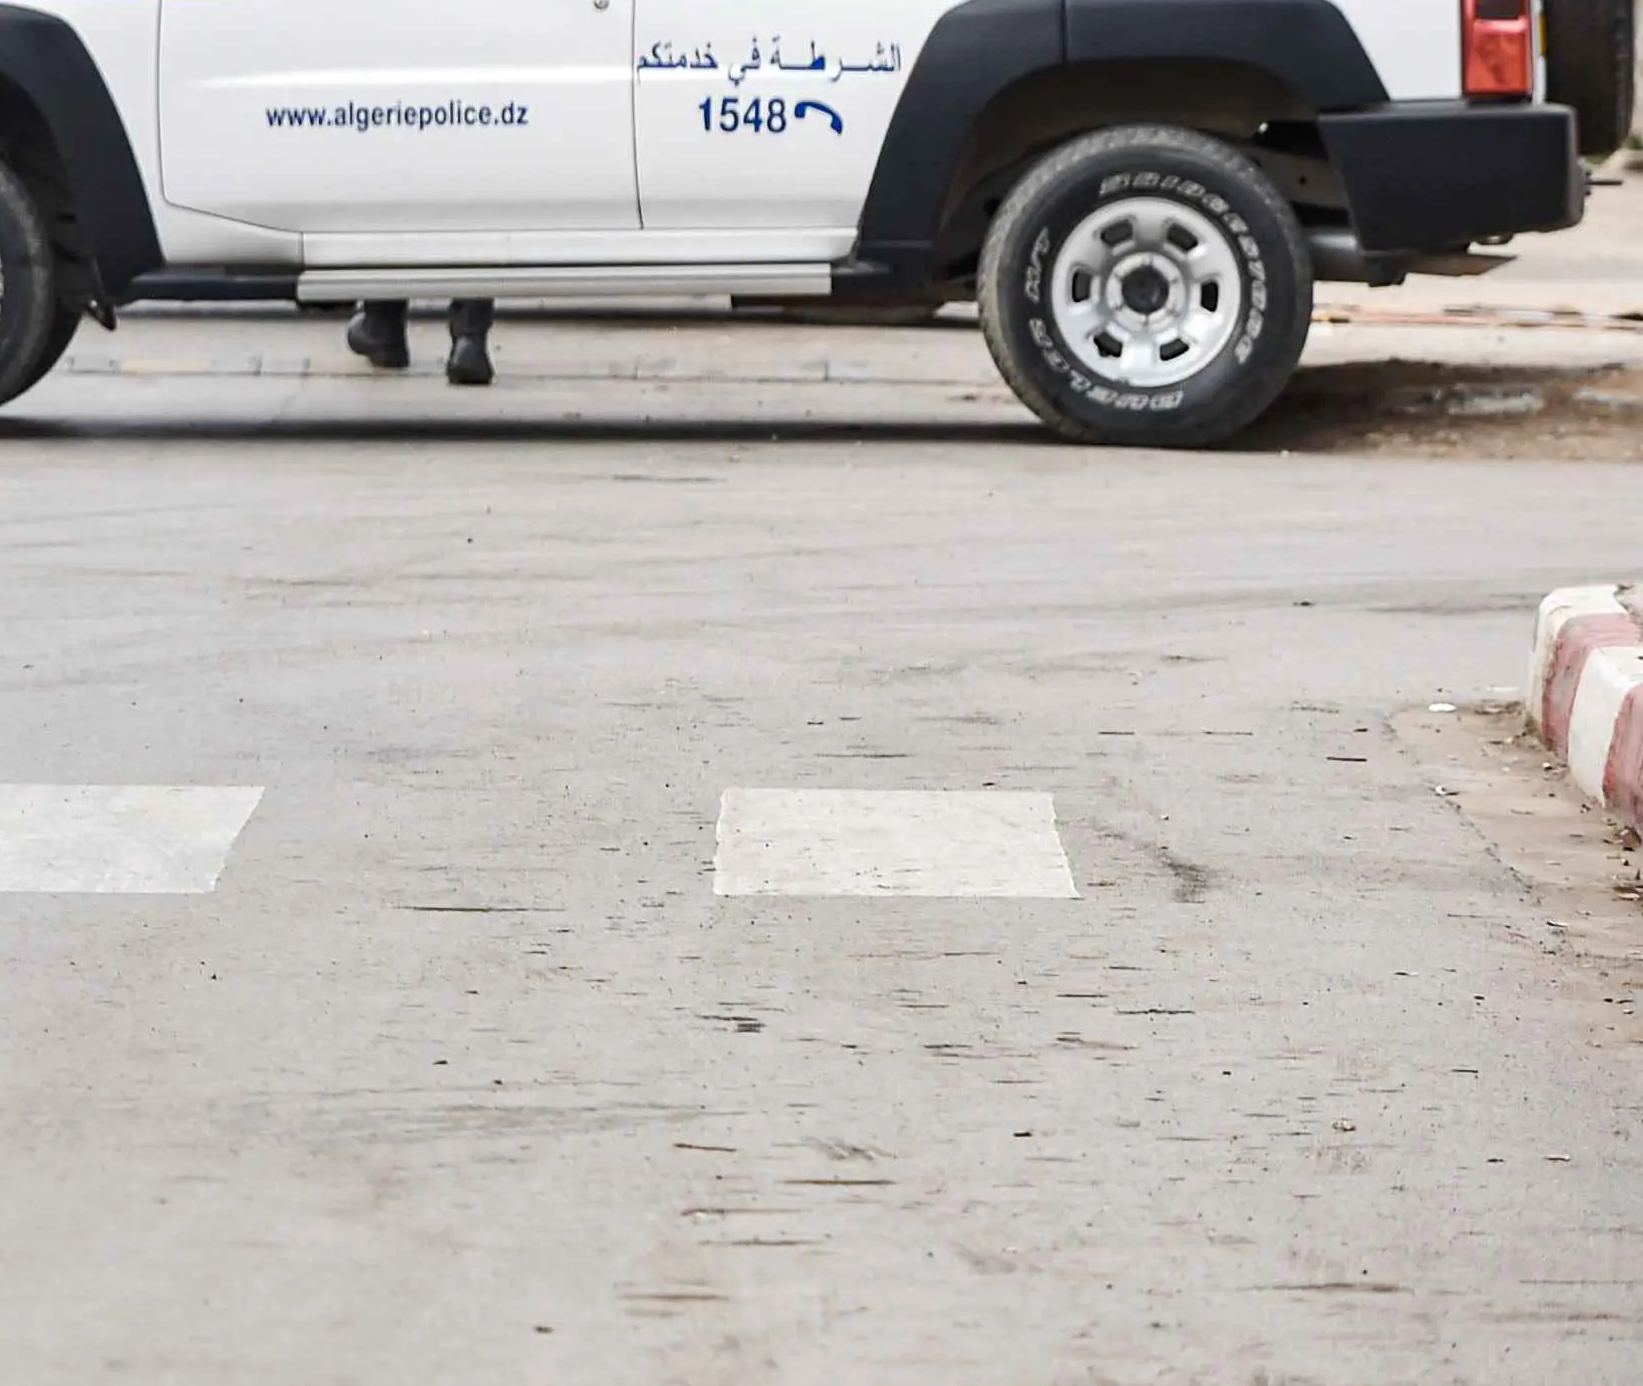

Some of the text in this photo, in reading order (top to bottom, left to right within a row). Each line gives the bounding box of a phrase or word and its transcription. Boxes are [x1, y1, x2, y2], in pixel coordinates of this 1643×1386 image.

[636, 41, 719, 84] خدمتكم
[728, 36, 761, 86] في
[265, 100, 529, 132] www.algeriepolice.dz
[699, 96, 787, 133] 1548
